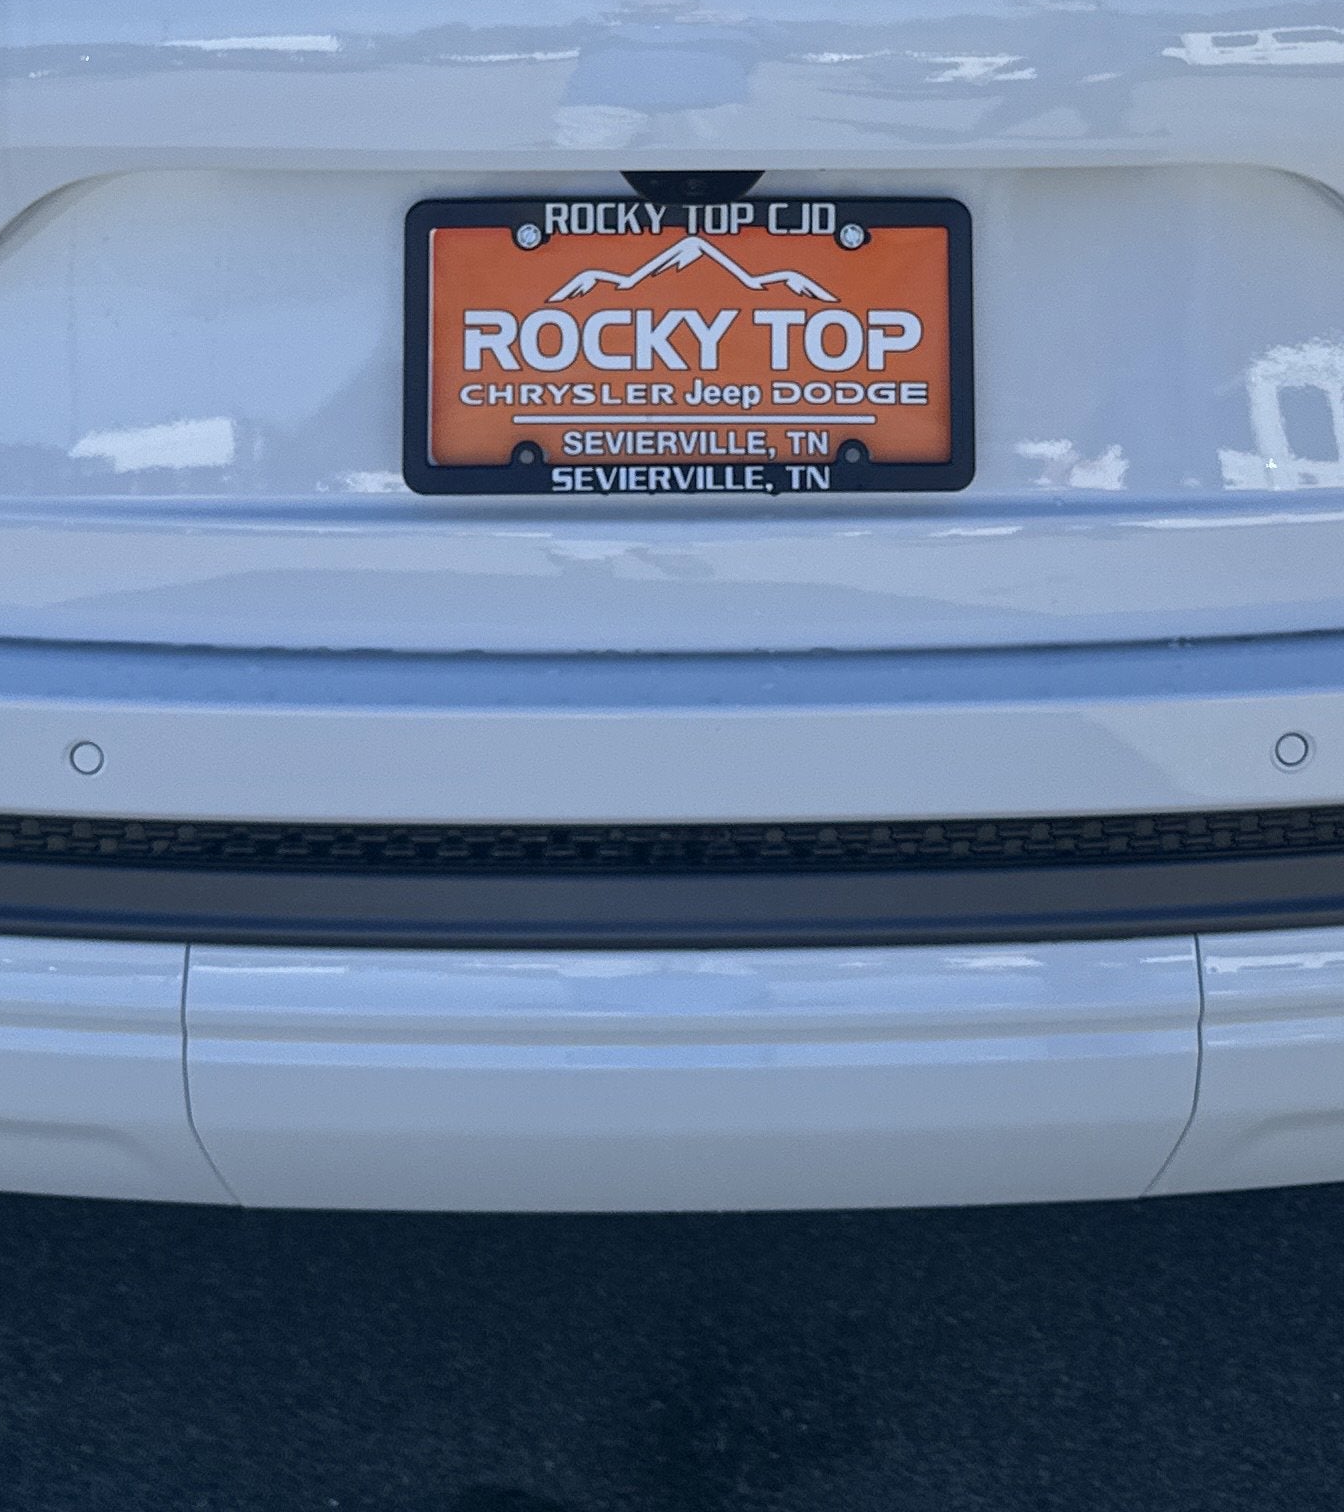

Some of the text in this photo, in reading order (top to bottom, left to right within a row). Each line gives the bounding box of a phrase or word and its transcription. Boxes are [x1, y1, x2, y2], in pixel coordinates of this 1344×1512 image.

[545, 202, 837, 236] ROCKY TOP CJD
[463, 308, 924, 372] ROCKY TOP
[459, 378, 929, 410] CHRYSLER Jeep DODGE
[562, 431, 830, 460] SEVIERVILLE, TN
[551, 466, 831, 493] SEVIERVILLE, TN
